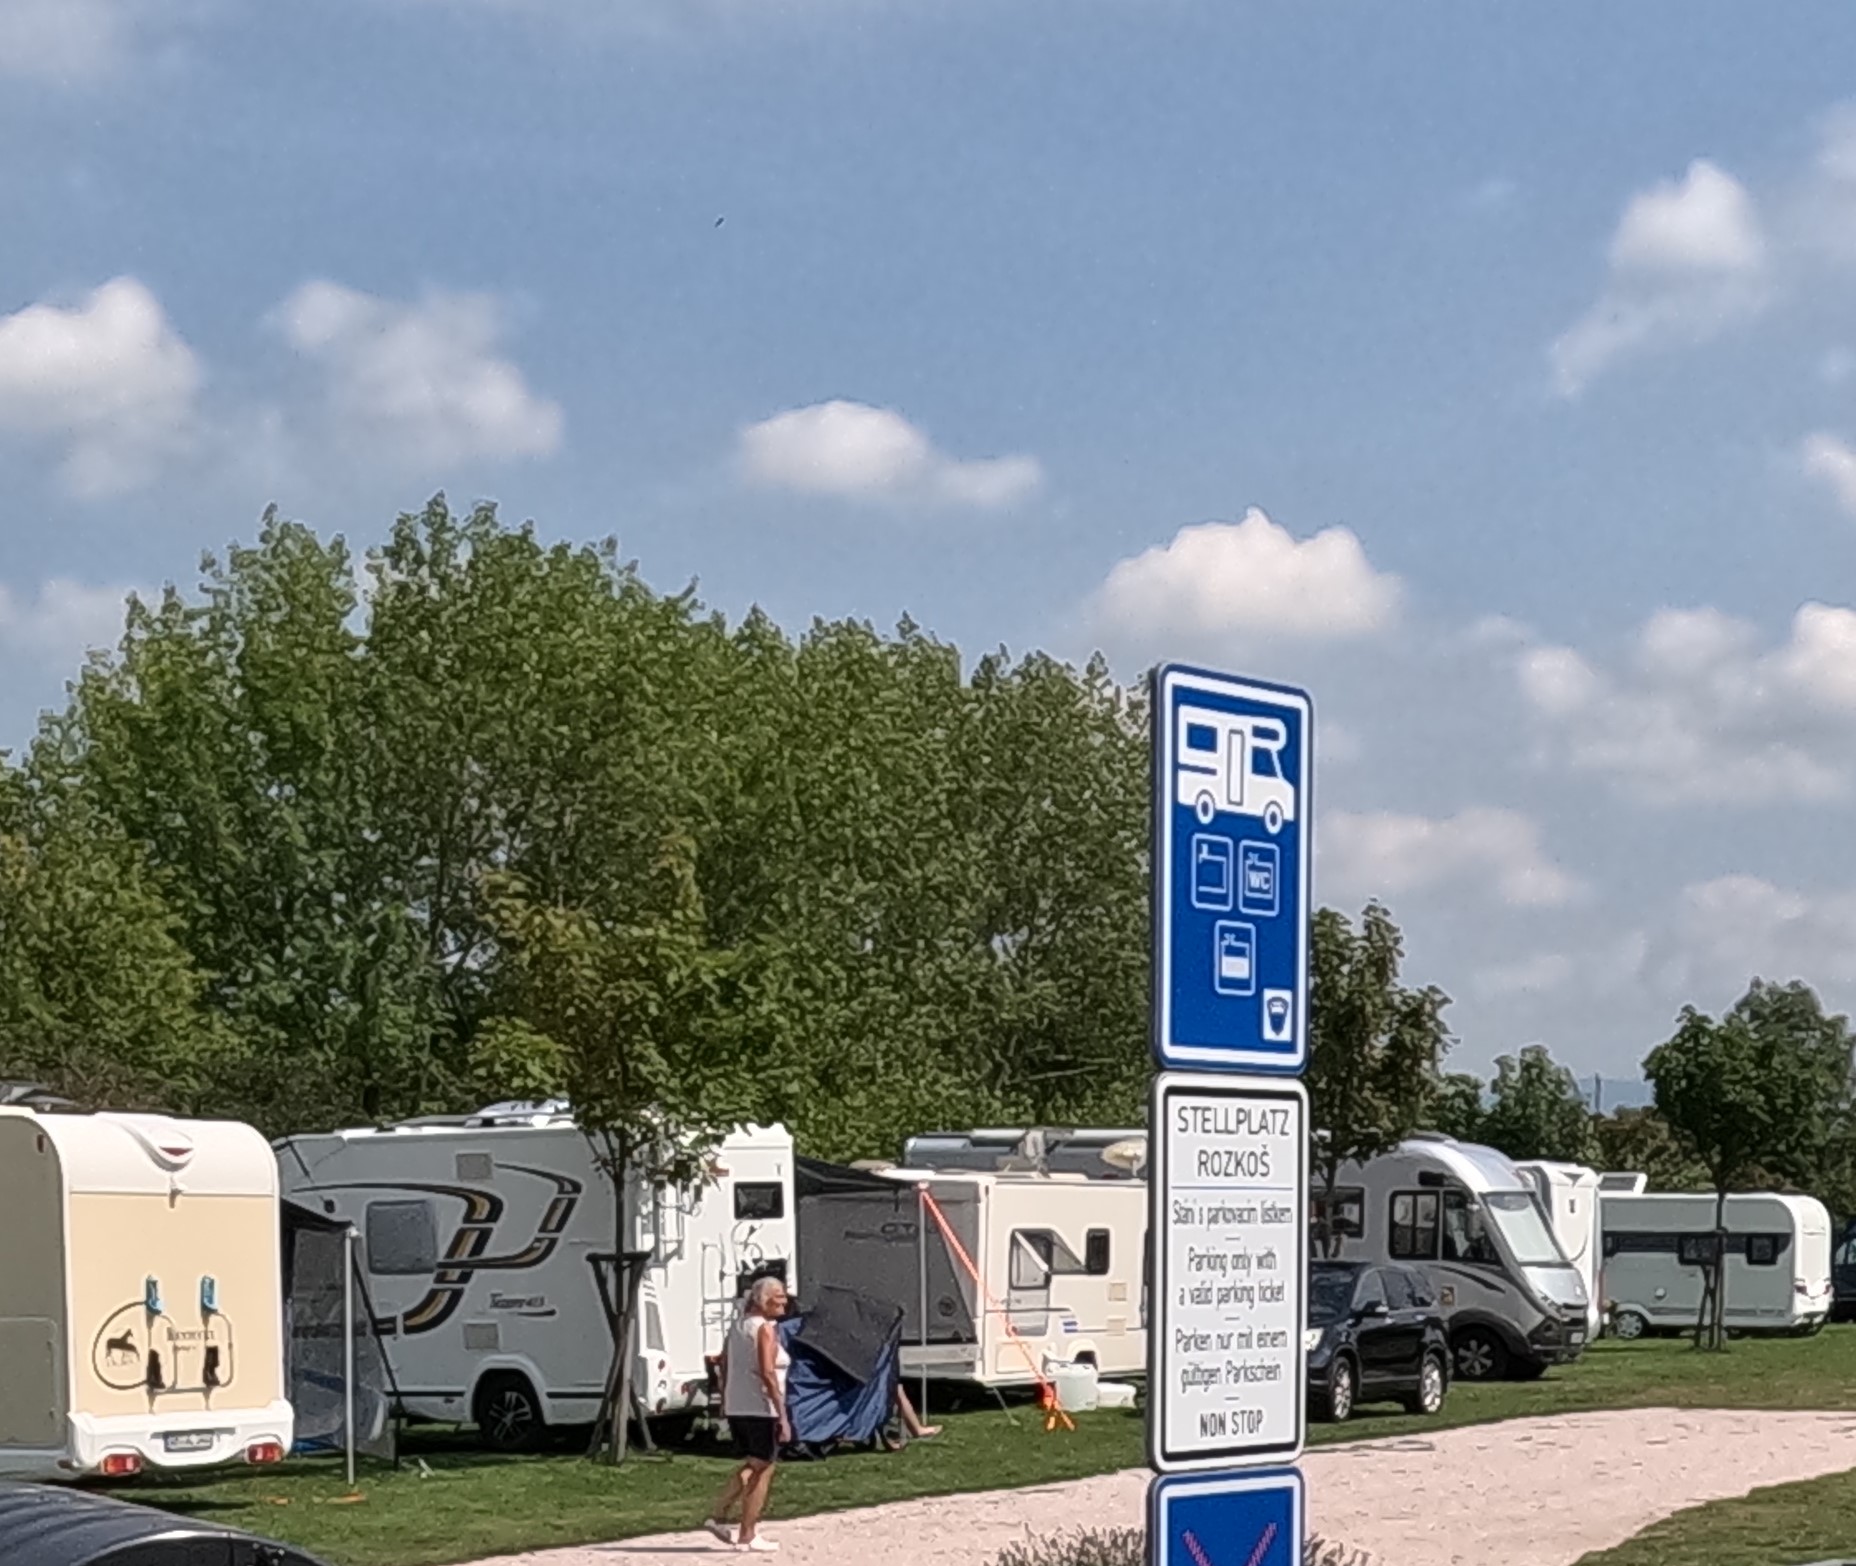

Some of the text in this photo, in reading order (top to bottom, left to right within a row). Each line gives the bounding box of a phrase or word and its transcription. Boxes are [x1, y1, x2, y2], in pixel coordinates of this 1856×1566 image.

[1178, 1106, 1290, 1136] STELLPLATZ
[1197, 1145, 1270, 1177] ROZKOŠ
[1188, 1246, 1228, 1278] Parking
[1232, 1246, 1252, 1277] only
[1217, 1279, 1254, 1310] parking
[1176, 1327, 1212, 1352] Parken
[1200, 1410, 1263, 1438] NON STOP
